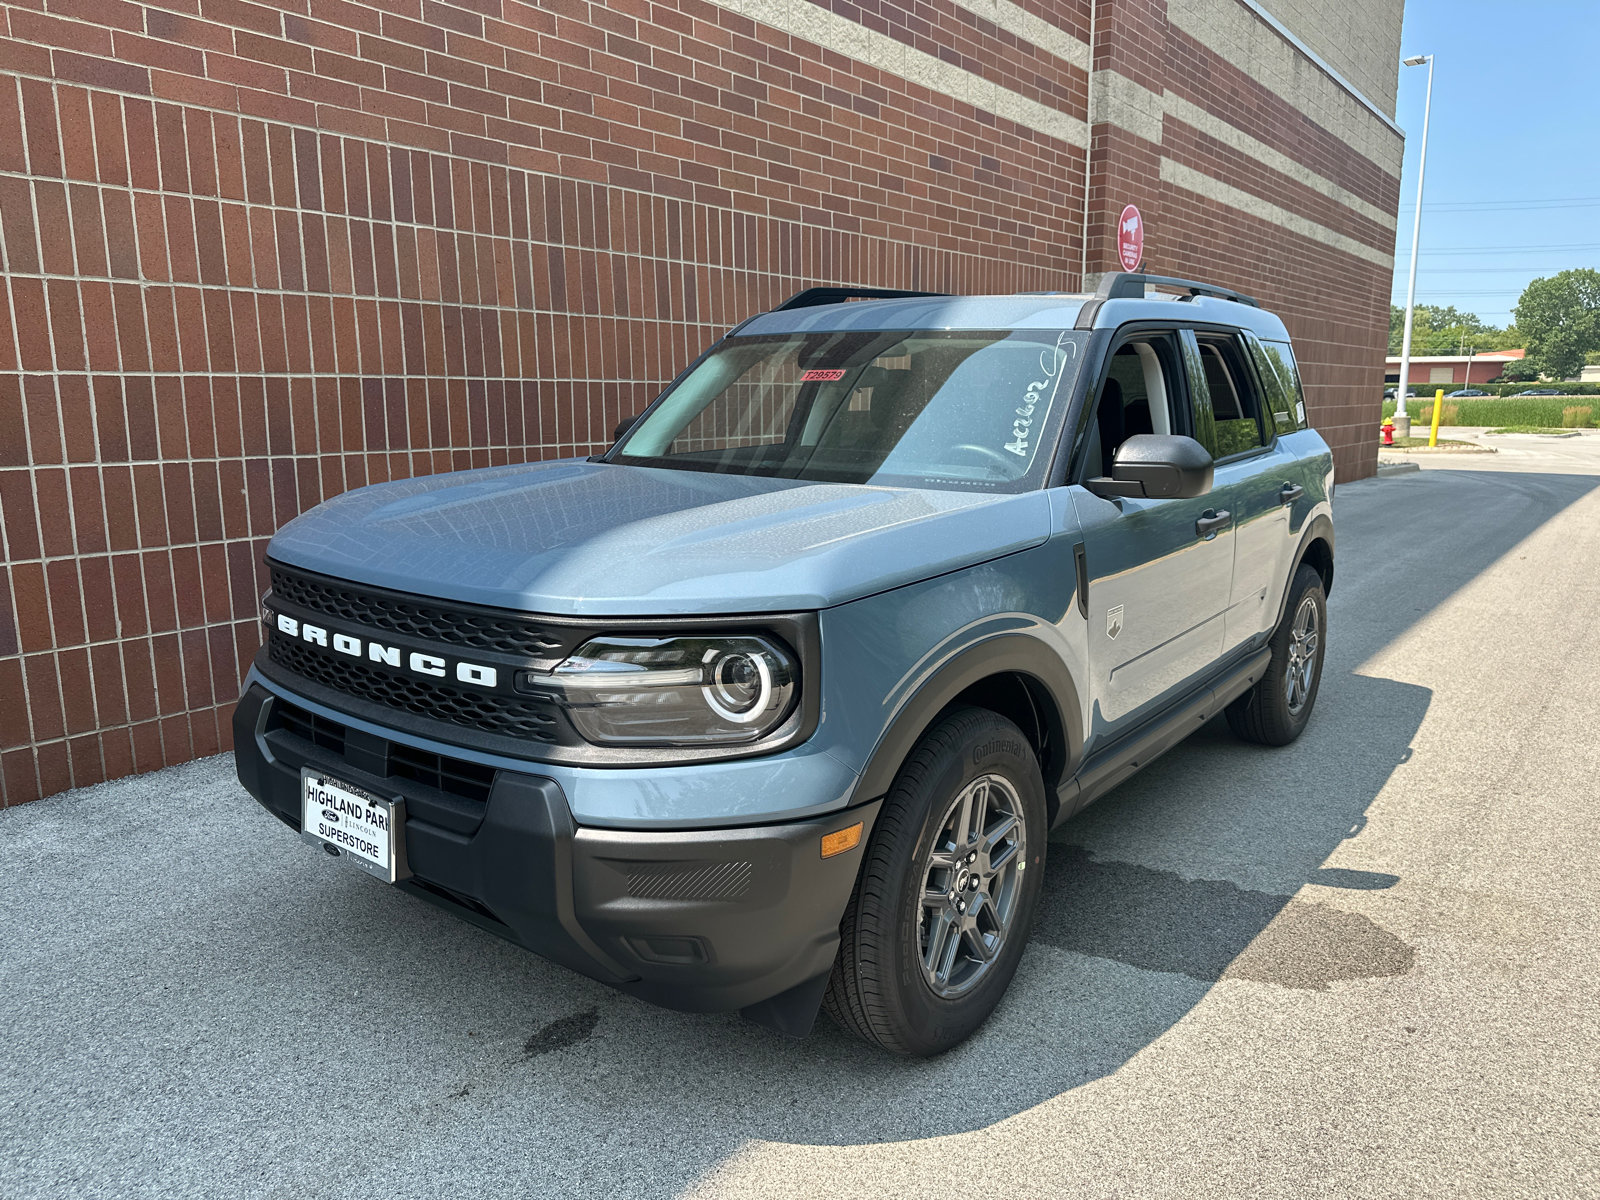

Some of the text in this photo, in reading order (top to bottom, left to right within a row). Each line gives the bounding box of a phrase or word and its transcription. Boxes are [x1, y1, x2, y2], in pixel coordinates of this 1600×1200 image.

[277, 613, 497, 688] BRONCO
[973, 738, 1022, 765] Continental
[307, 785, 362, 820] HIGHLAND
[318, 822, 379, 859] SUPERSTORE
[323, 809, 377, 838] Ford LINCOLN
